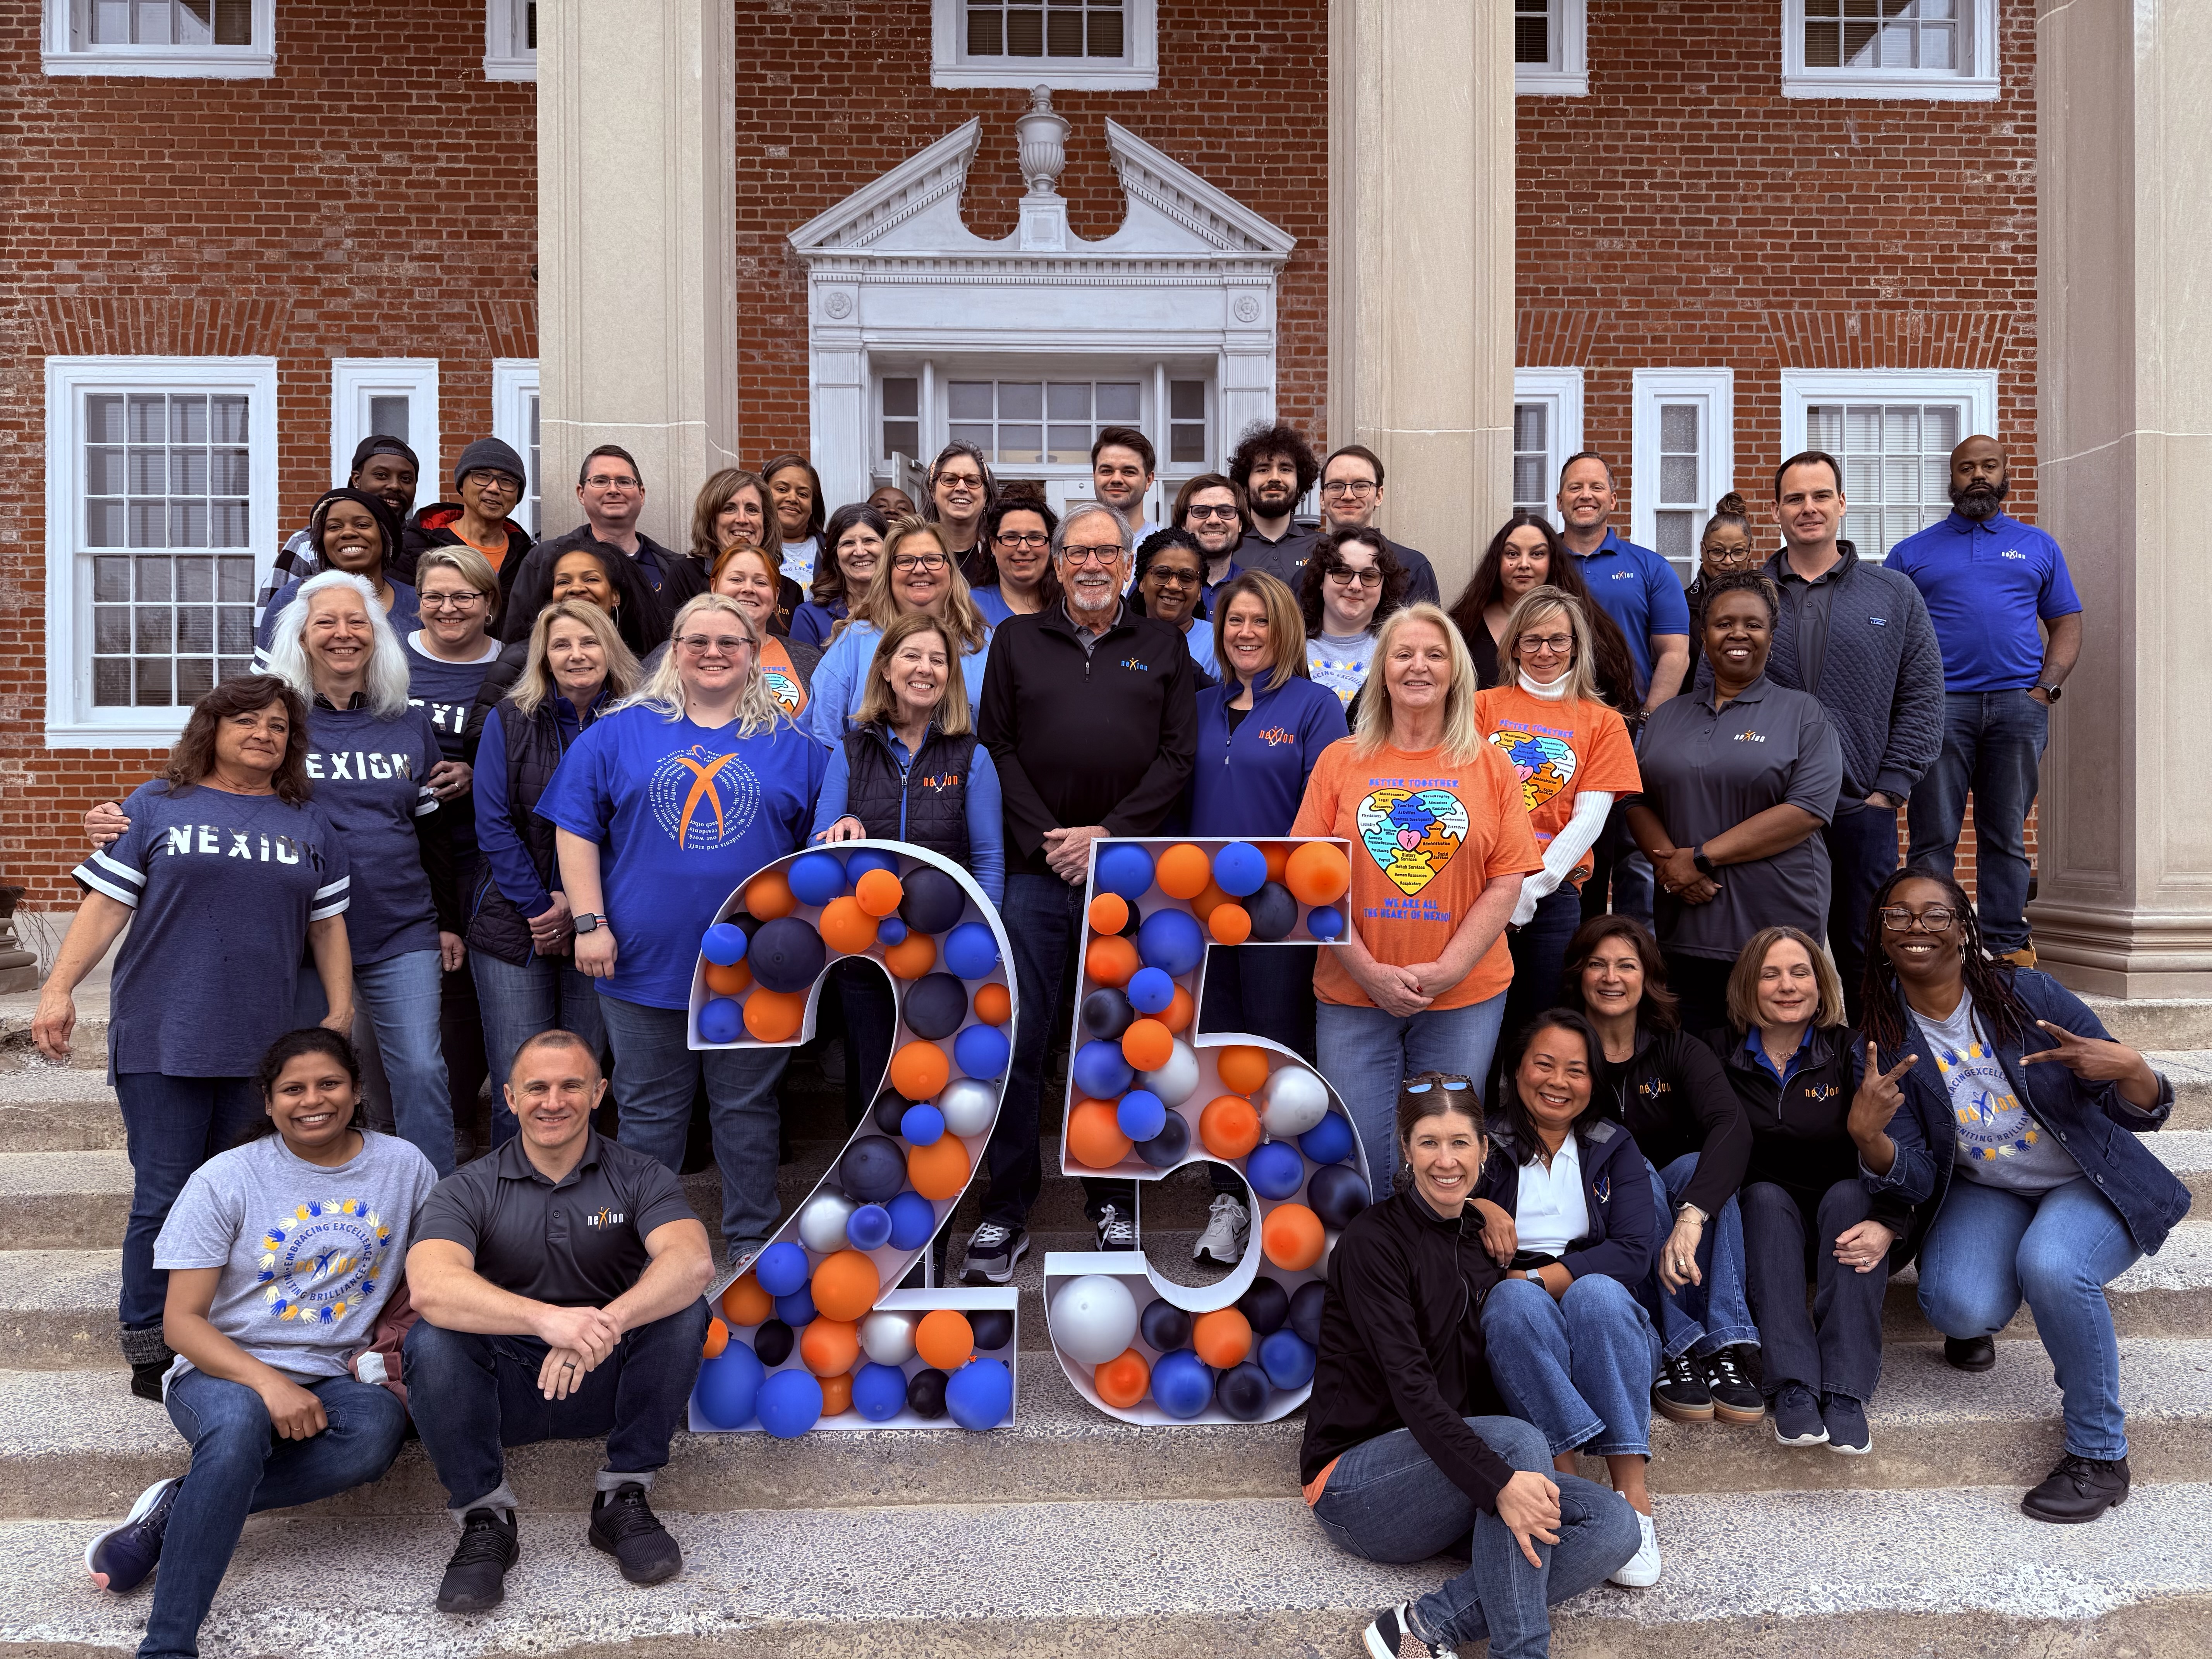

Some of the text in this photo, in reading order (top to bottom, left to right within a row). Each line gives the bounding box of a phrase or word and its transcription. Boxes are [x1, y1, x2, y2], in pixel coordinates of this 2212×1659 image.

[306, 751, 413, 781] EXION
[664, 754, 685, 766] culture.
[728, 760, 745, 772] honest
[653, 766, 663, 777] peer
[657, 762, 678, 790] environment
[668, 764, 686, 777] Nexion
[677, 771, 686, 780] and
[743, 763, 755, 777] needs
[744, 772, 752, 781] and
[721, 768, 740, 796] community.
[670, 780, 678, 800] dignity
[743, 783, 754, 816] dependable.
[665, 802, 680, 824] families
[672, 802, 681, 815] with
[724, 807, 735, 819] treat
[653, 809, 669, 832] maintain
[661, 809, 673, 825] ensure
[724, 819, 733, 828] our
[672, 824, 679, 833] We
[723, 825, 737, 836] enjoy
[668, 832, 675, 840] We
[720, 830, 745, 847] residents
[1384, 898, 1438, 910] WE ARE ALL
[1364, 908, 1378, 917] THE
[1380, 908, 1408, 919] HEART
[1410, 910, 1421, 920] OF
[284, 1223, 372, 1266] EMBRACING EXCELLENCE
[309, 1268, 367, 1301] BRILLIANCE
